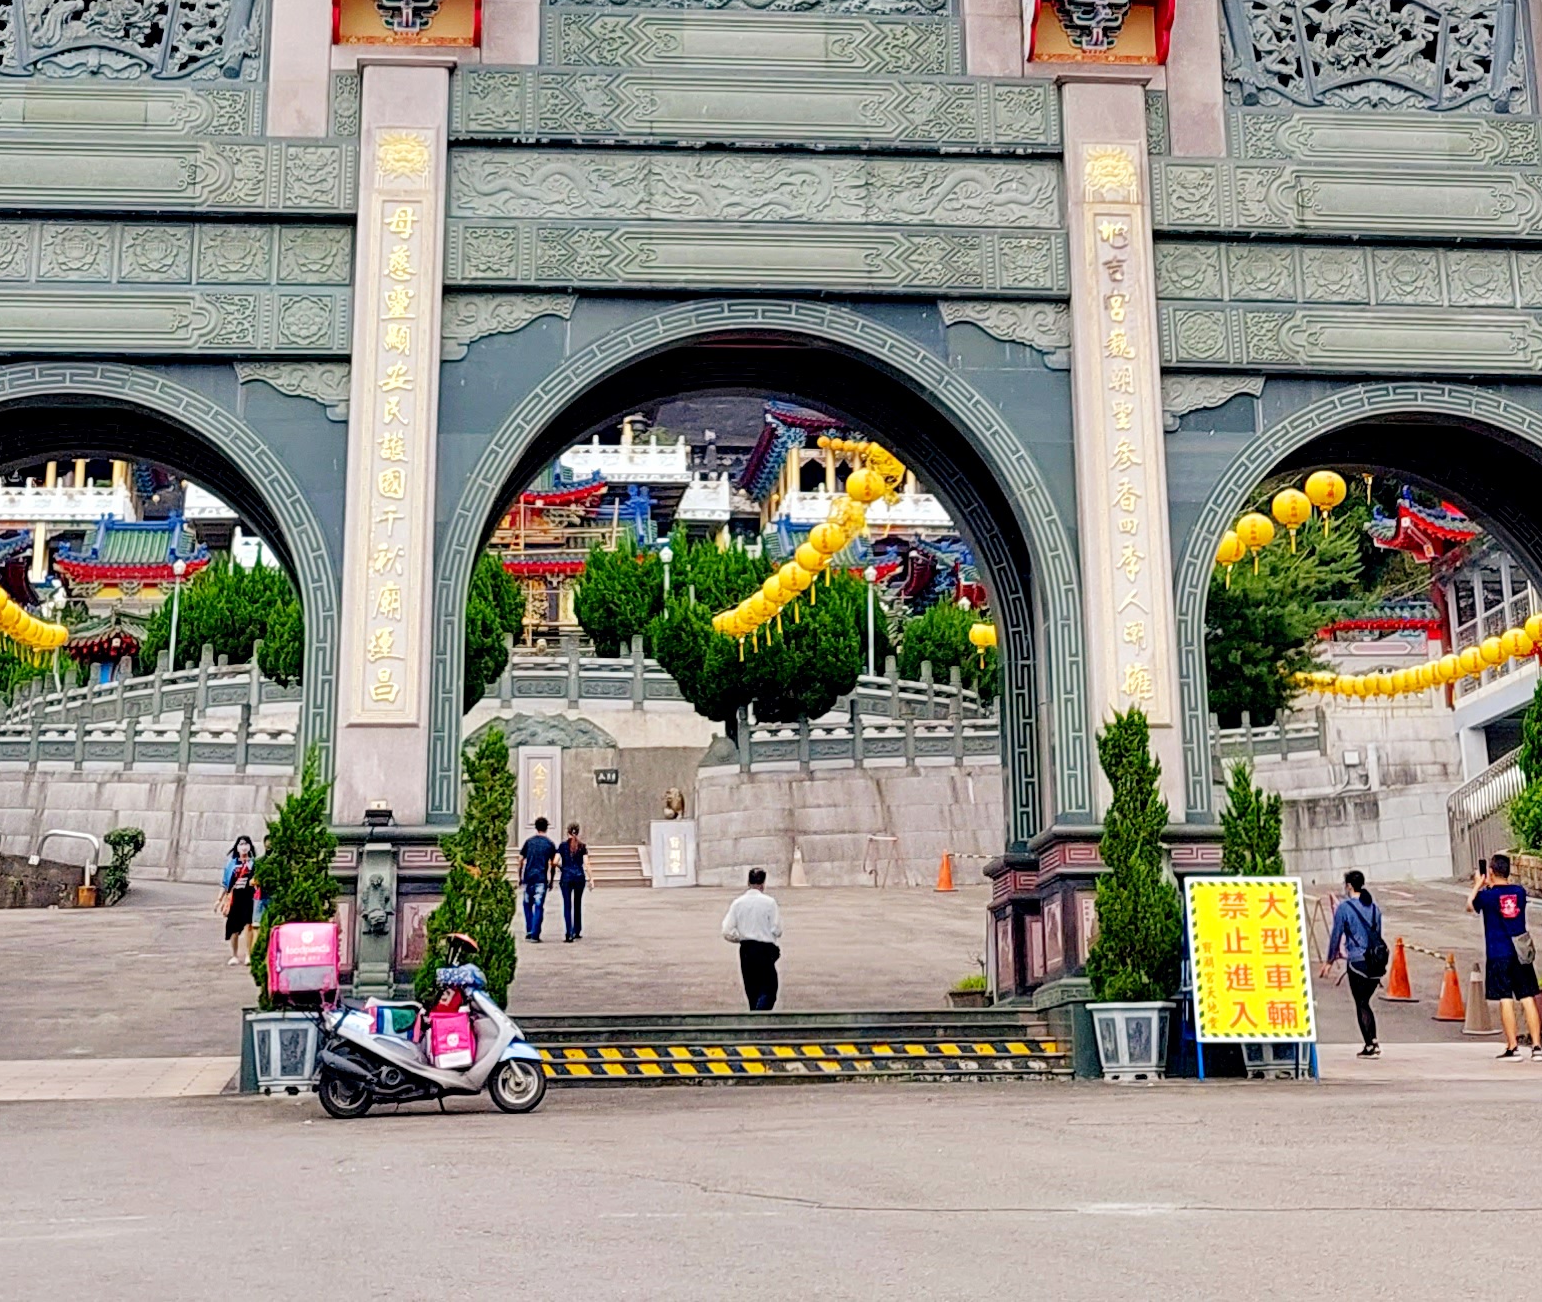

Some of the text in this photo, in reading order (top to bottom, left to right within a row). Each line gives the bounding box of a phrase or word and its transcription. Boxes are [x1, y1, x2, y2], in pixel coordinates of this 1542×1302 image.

[1218, 891, 1258, 1030] 禁止進入
[1259, 891, 1298, 1030] 大型車輛
